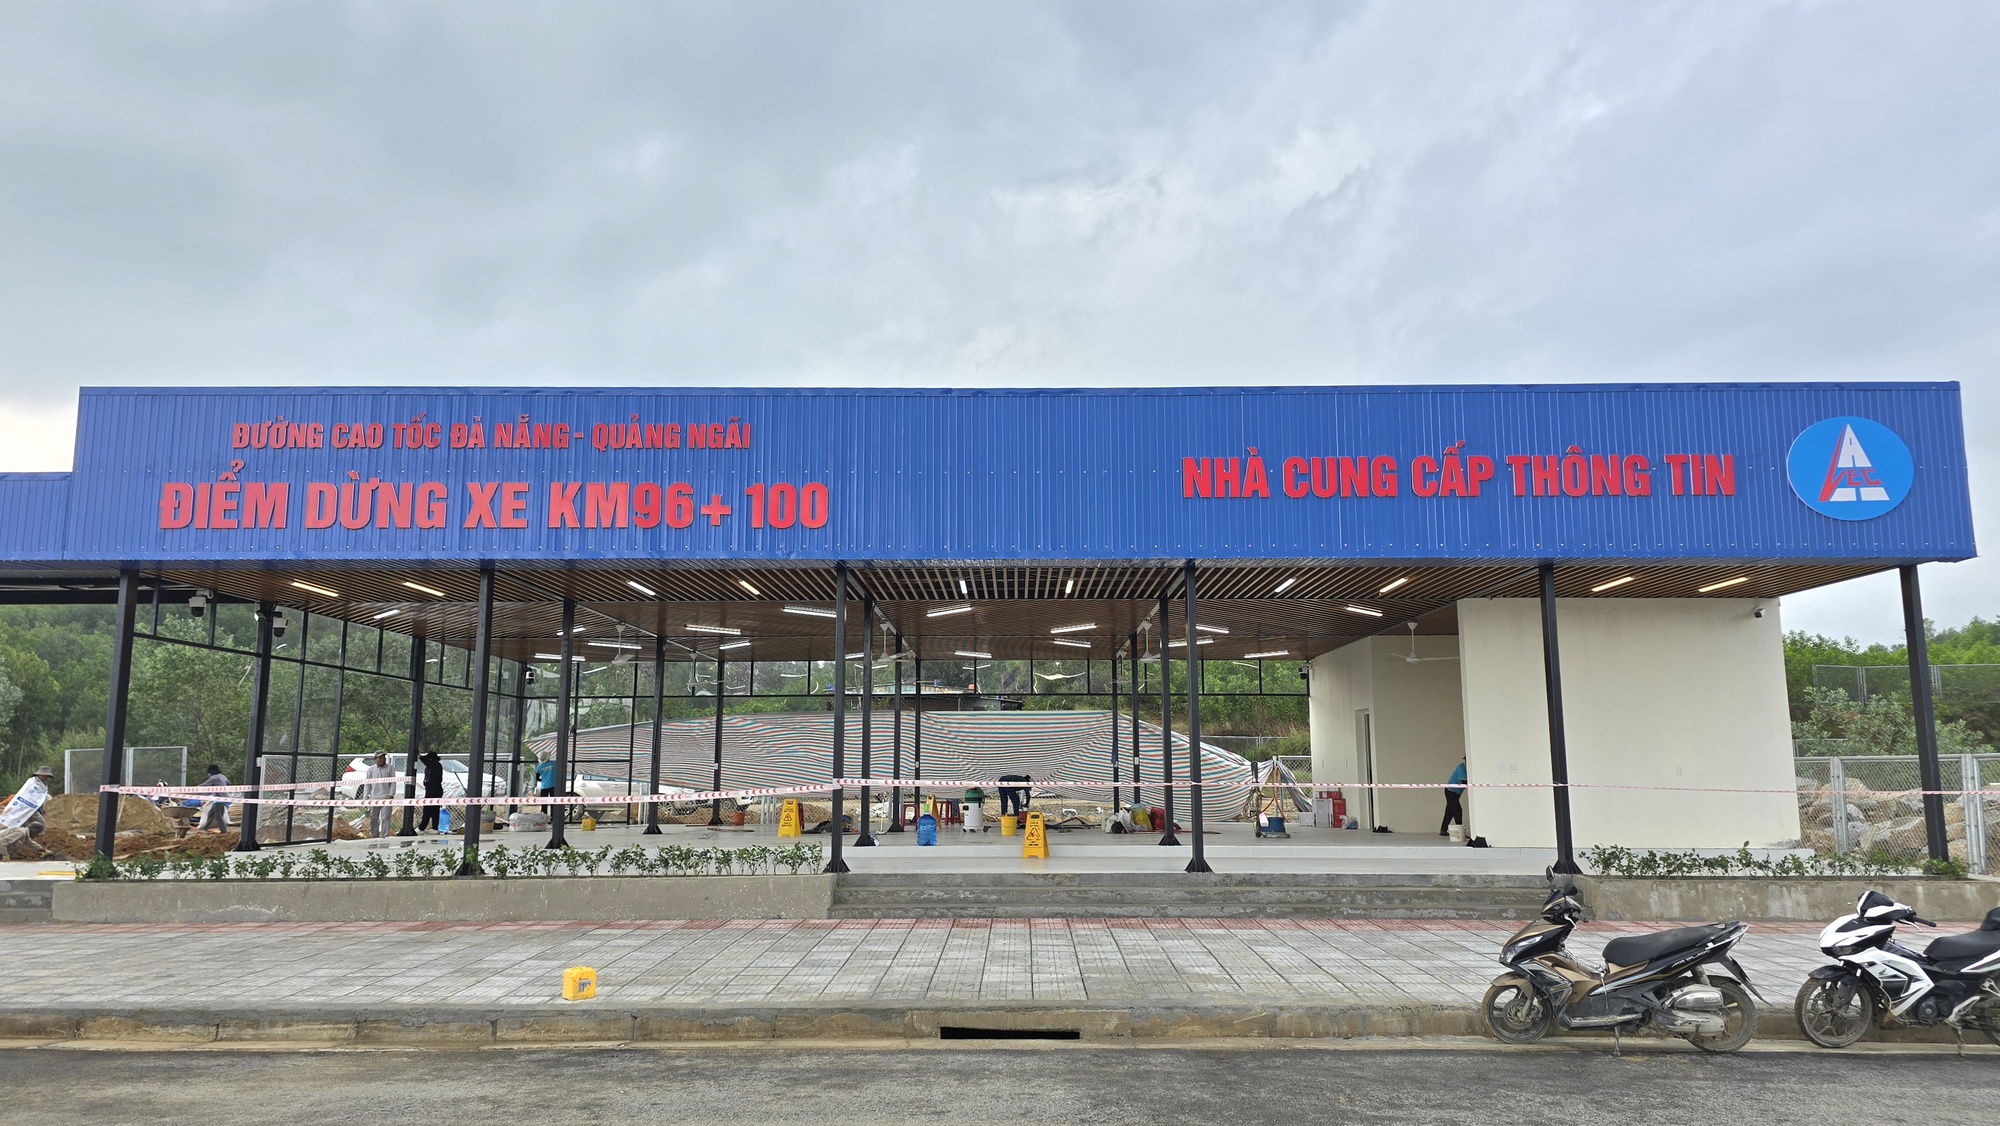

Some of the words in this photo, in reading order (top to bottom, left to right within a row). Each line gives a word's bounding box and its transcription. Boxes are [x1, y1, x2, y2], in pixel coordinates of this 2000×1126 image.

[232, 416, 324, 449] ĐƯỜNG
[331, 423, 384, 449] CAO
[392, 412, 441, 449] TỐC
[450, 416, 486, 449] ĐÀ
[494, 413, 570, 449] NẴNG
[592, 414, 681, 452] QUẢNG
[688, 417, 751, 449] NGÃI
[159, 459, 291, 530] ĐIỂM
[304, 471, 448, 530] DỪNG
[462, 482, 530, 530] XE
[1182, 447, 1271, 499] NHÀ
[1283, 456, 1398, 499] CUNG
[1411, 439, 1495, 498] CẤP
[1506, 445, 1651, 498] THÔNG
[1664, 454, 1736, 497] TIN
